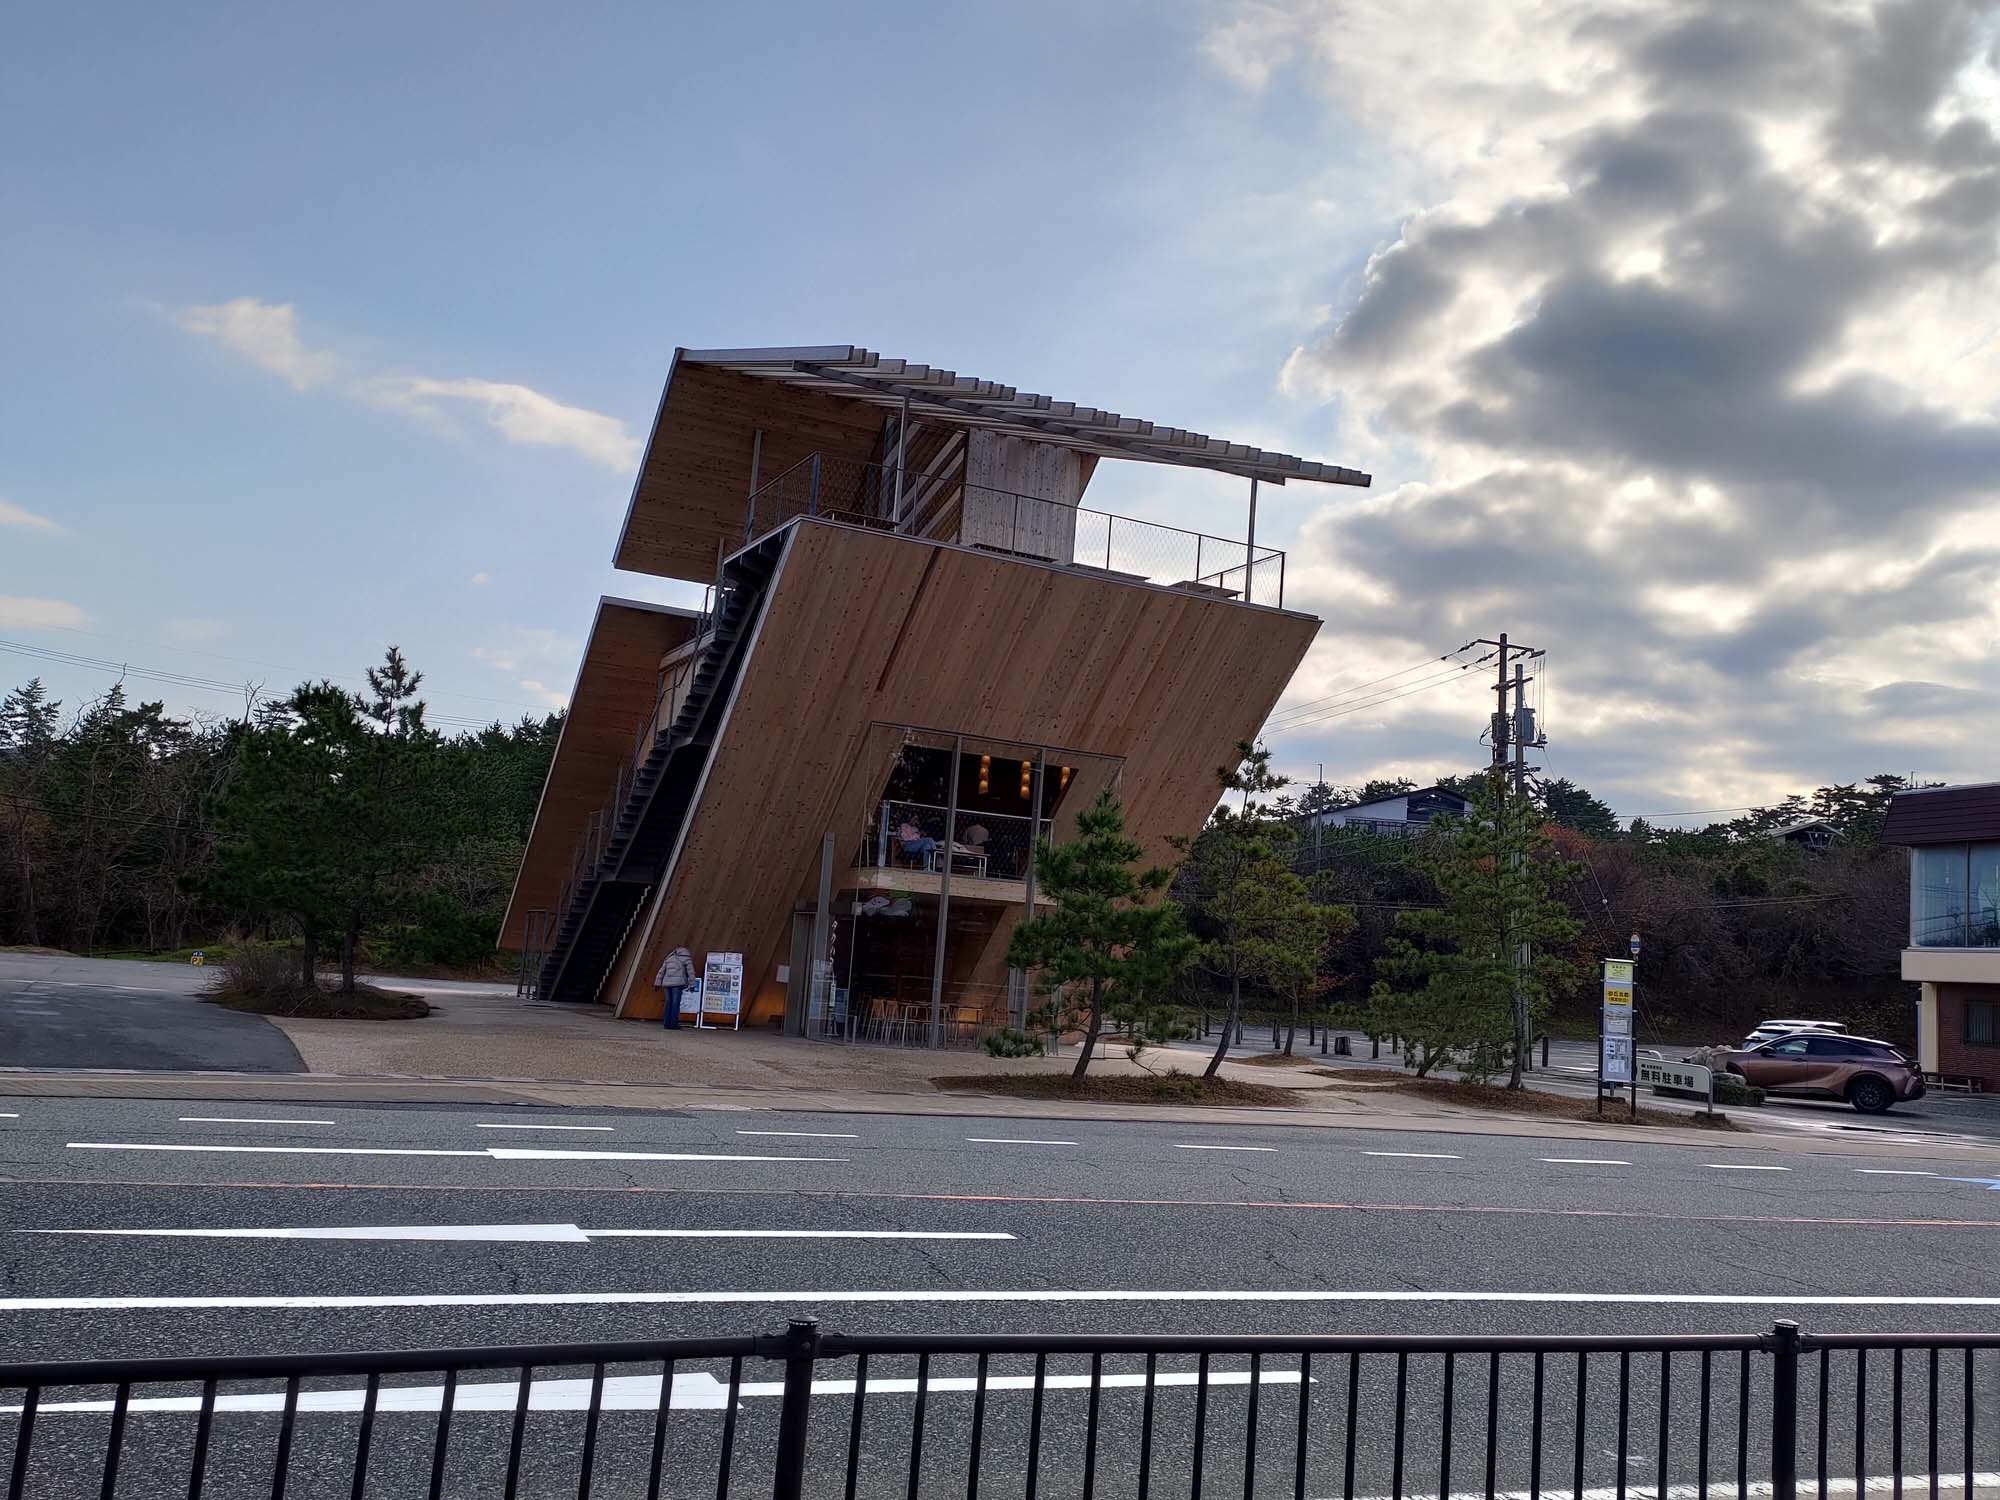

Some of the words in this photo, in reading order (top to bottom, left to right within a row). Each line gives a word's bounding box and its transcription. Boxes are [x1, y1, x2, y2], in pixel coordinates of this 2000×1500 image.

[1641, 1069, 1694, 1088] 無料駐車場
